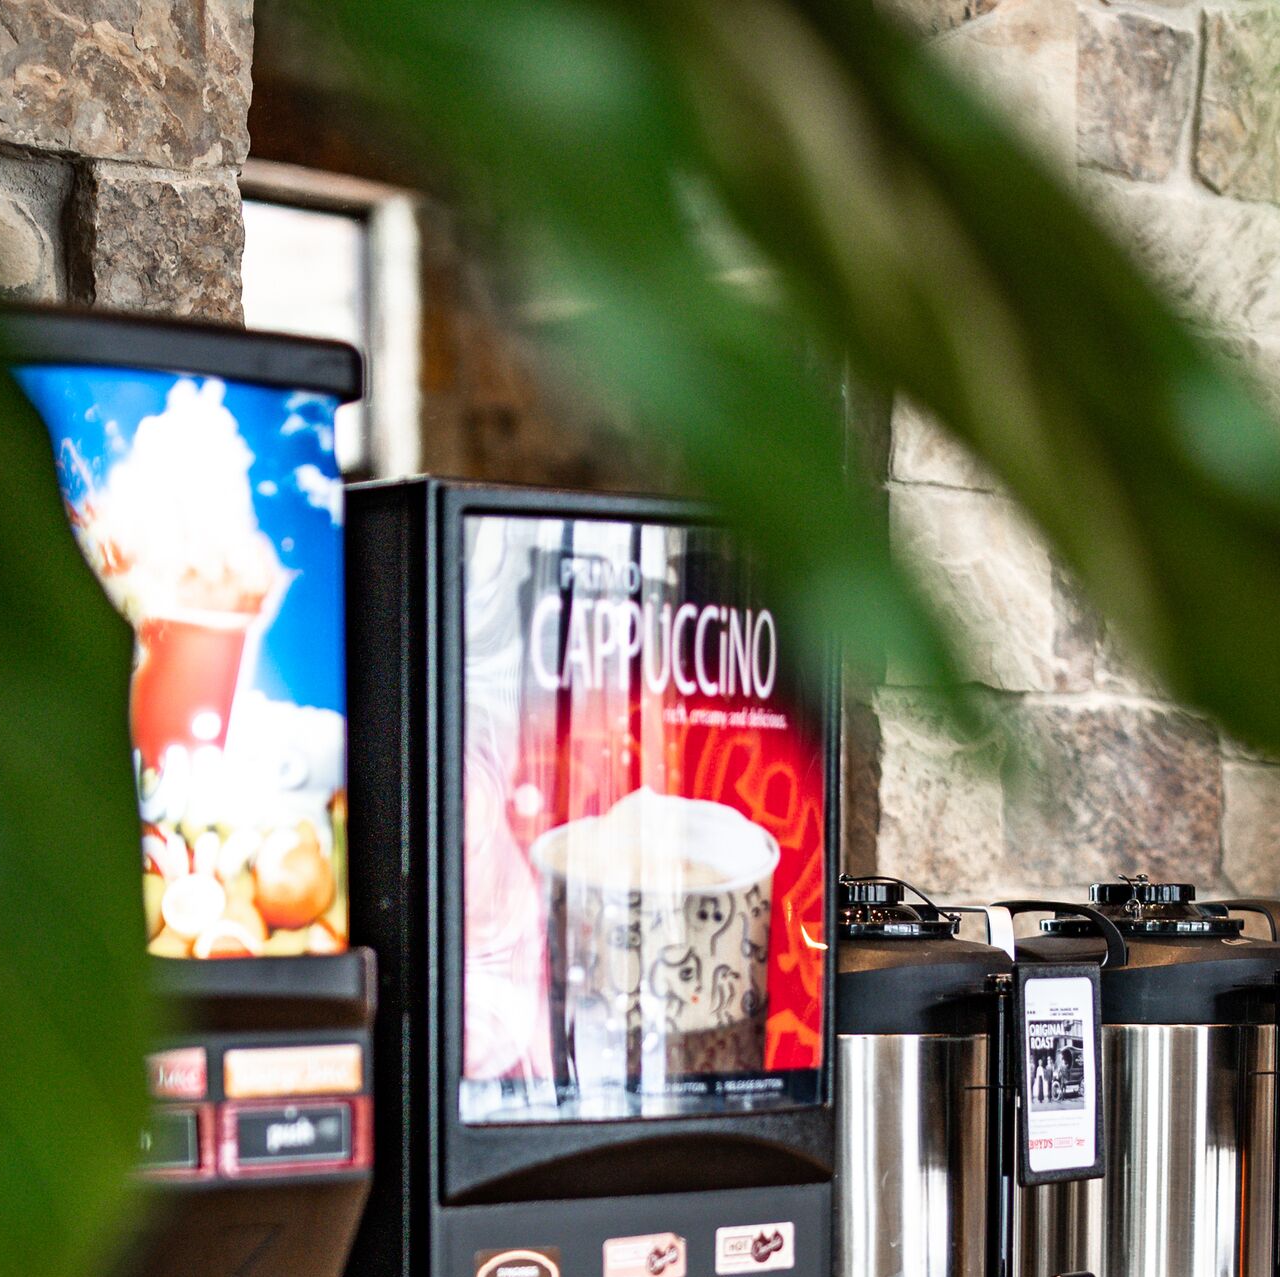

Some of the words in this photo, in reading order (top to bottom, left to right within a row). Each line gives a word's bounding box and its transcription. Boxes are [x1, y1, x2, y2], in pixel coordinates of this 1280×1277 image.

[728, 706, 747, 728] and
[1029, 1023, 1065, 1038] ORIGINAL
[1030, 1037, 1054, 1050] ROAST
[266, 1116, 316, 1154] push
